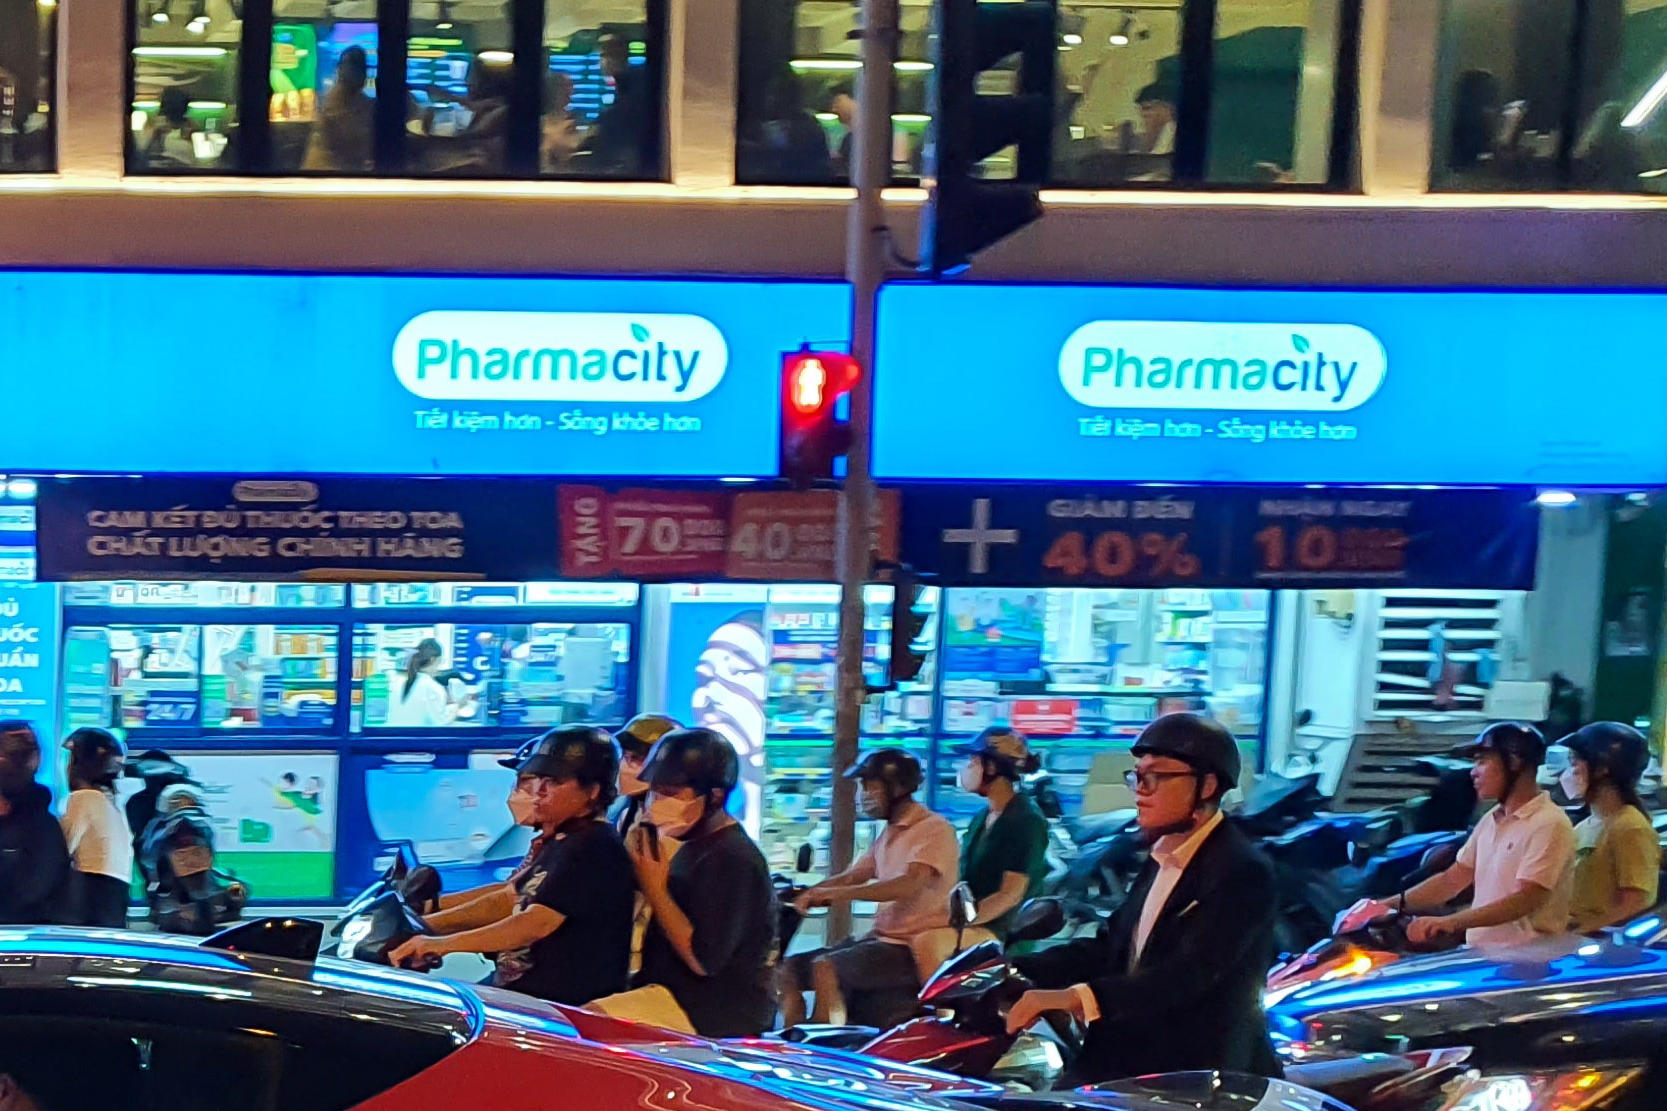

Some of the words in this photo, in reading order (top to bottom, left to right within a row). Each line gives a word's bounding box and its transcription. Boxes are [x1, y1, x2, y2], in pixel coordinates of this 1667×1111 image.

[417, 324, 700, 392] Pharmacity
[1082, 334, 1358, 403] Pharmacity
[1042, 531, 1201, 577] 40%
